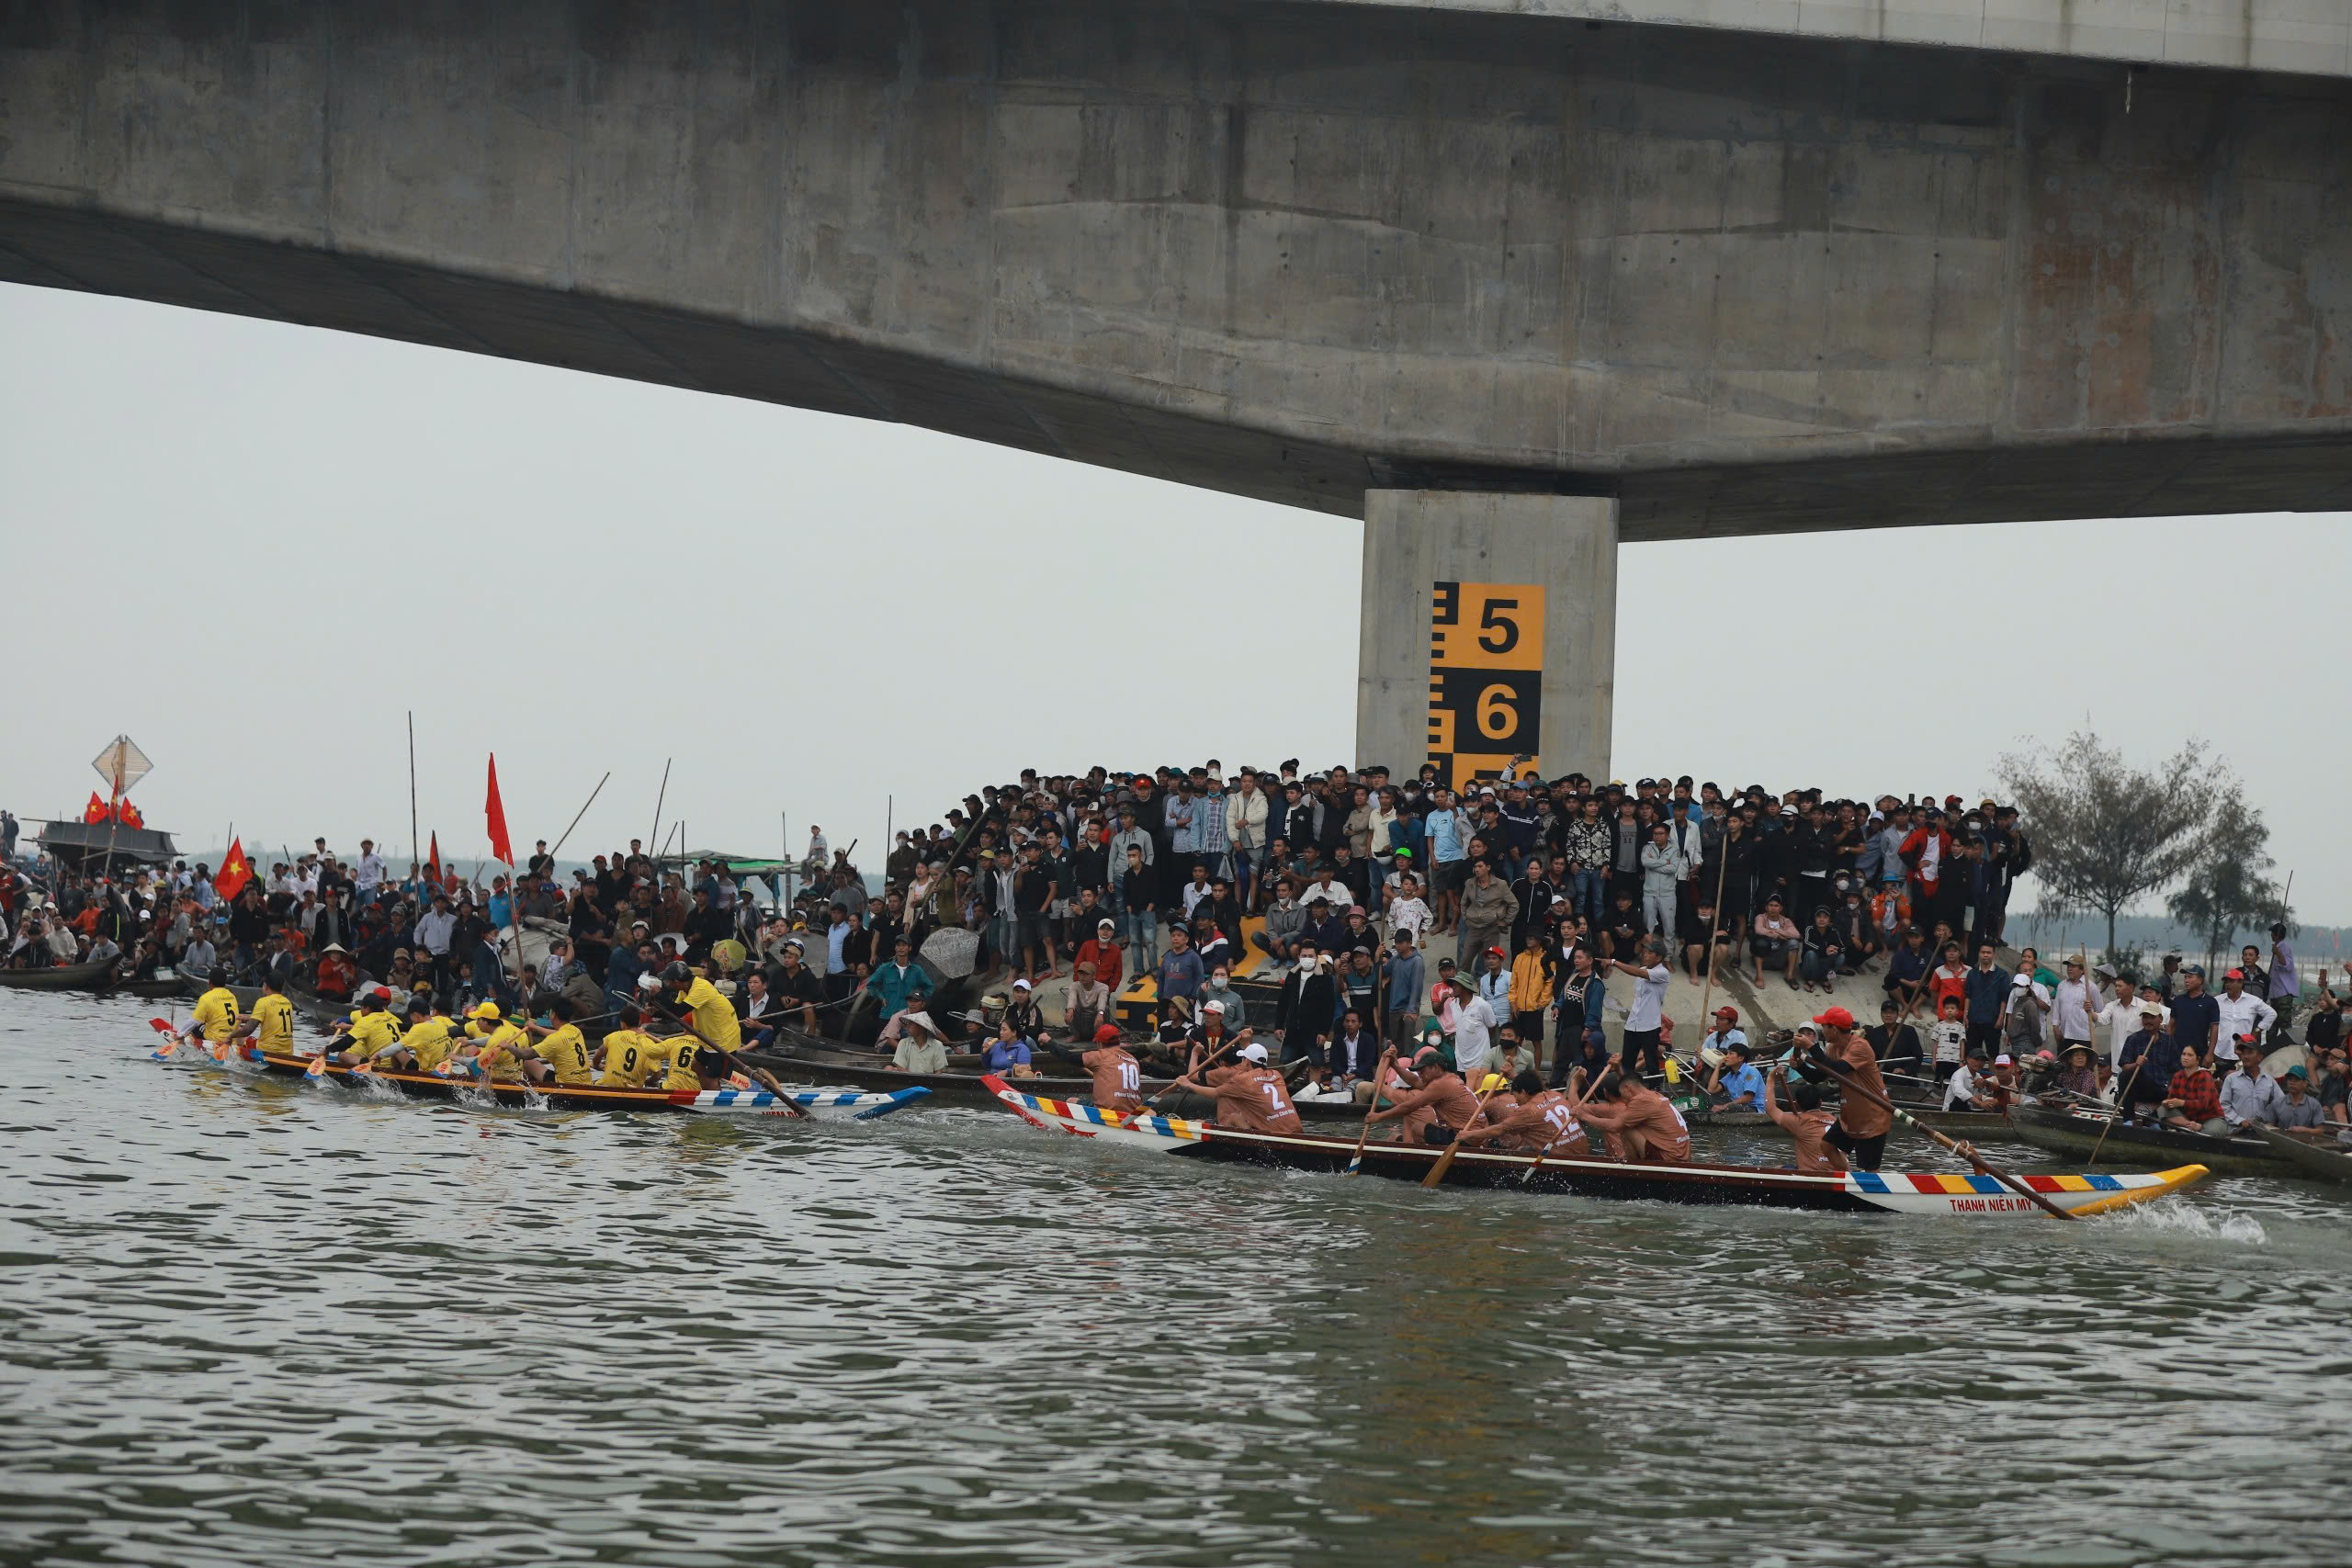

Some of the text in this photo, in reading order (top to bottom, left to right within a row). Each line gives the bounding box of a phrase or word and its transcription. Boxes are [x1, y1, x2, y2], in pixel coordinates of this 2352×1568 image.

[1477, 598, 1520, 655] 5
[1476, 682, 1519, 740] 6
[223, 1002, 236, 1027] 5
[278, 1008, 293, 1032] 11
[386, 1022, 401, 1043] 3
[574, 1042, 586, 1067] 8
[623, 1047, 638, 1073] 9
[677, 1045, 693, 1068] 6
[1117, 1062, 1140, 1091] 10
[1262, 1082, 1286, 1111] 2
[1544, 1104, 1580, 1136] 12
[1668, 1102, 1688, 1132] 4
[1949, 1199, 1986, 1213] THANH
[1987, 1194, 2015, 1213] NIÊN
